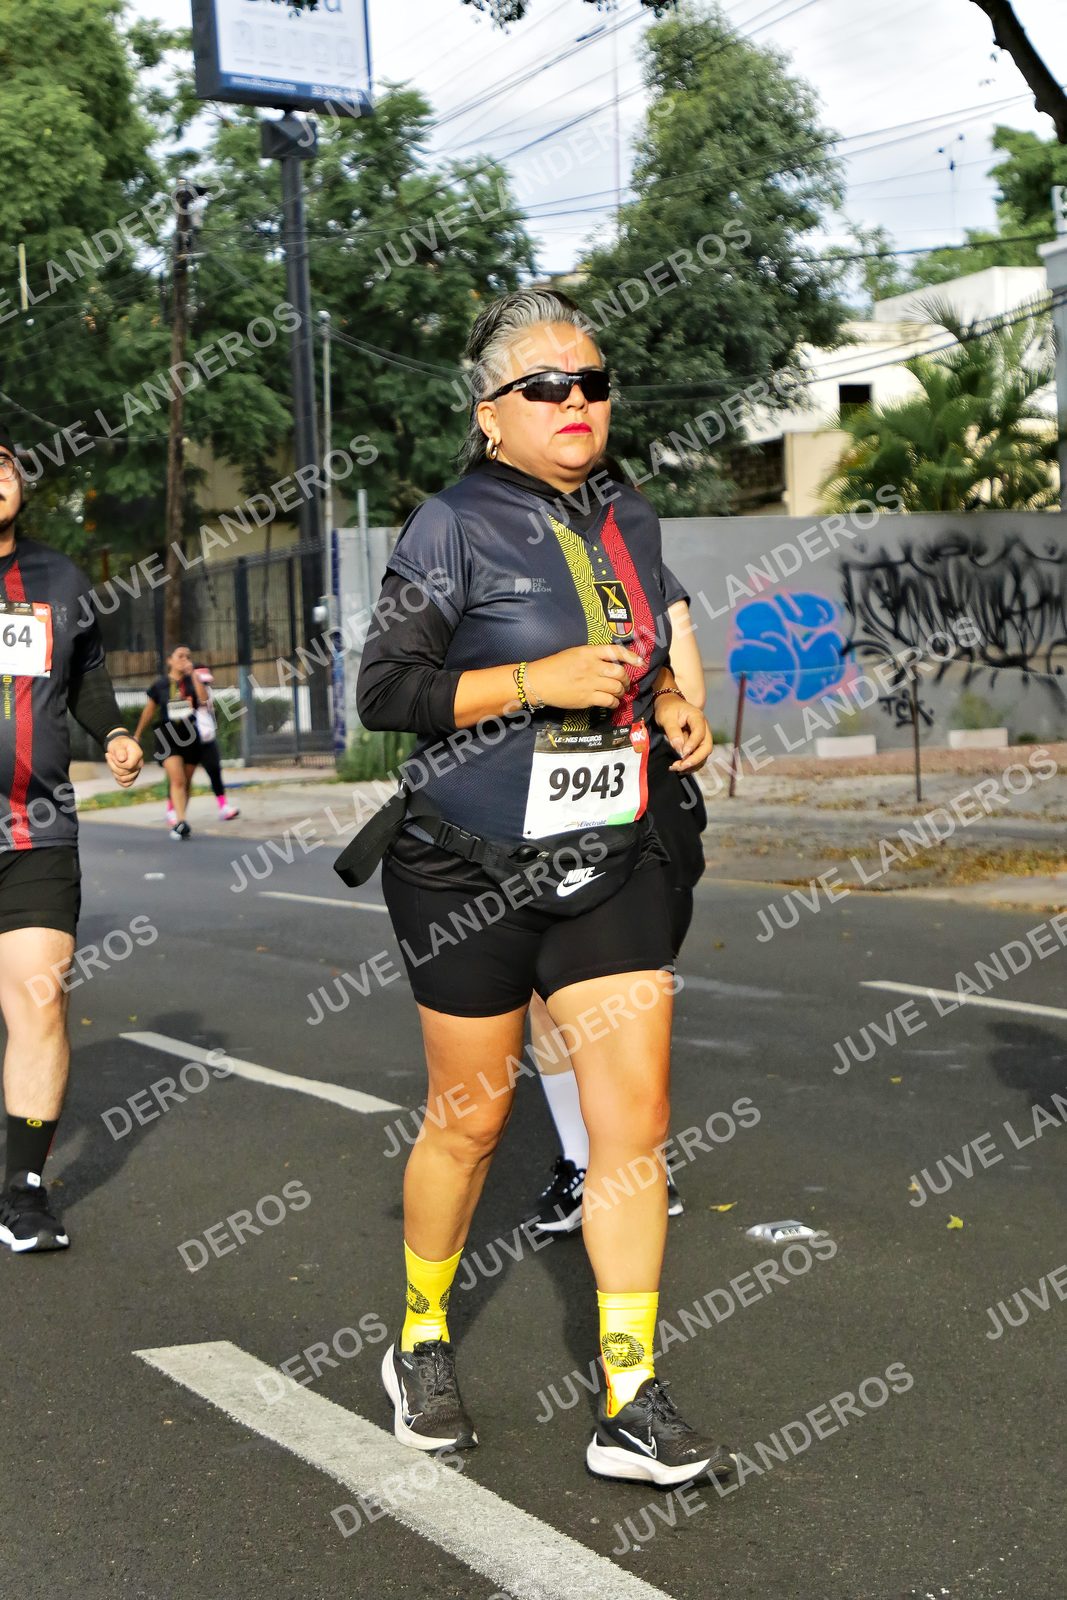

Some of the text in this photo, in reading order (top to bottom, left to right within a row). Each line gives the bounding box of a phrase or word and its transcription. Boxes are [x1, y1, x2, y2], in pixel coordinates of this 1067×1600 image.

[2, 623, 32, 648] 64
[549, 761, 626, 801] 9943
[564, 866, 596, 885] NIKE
